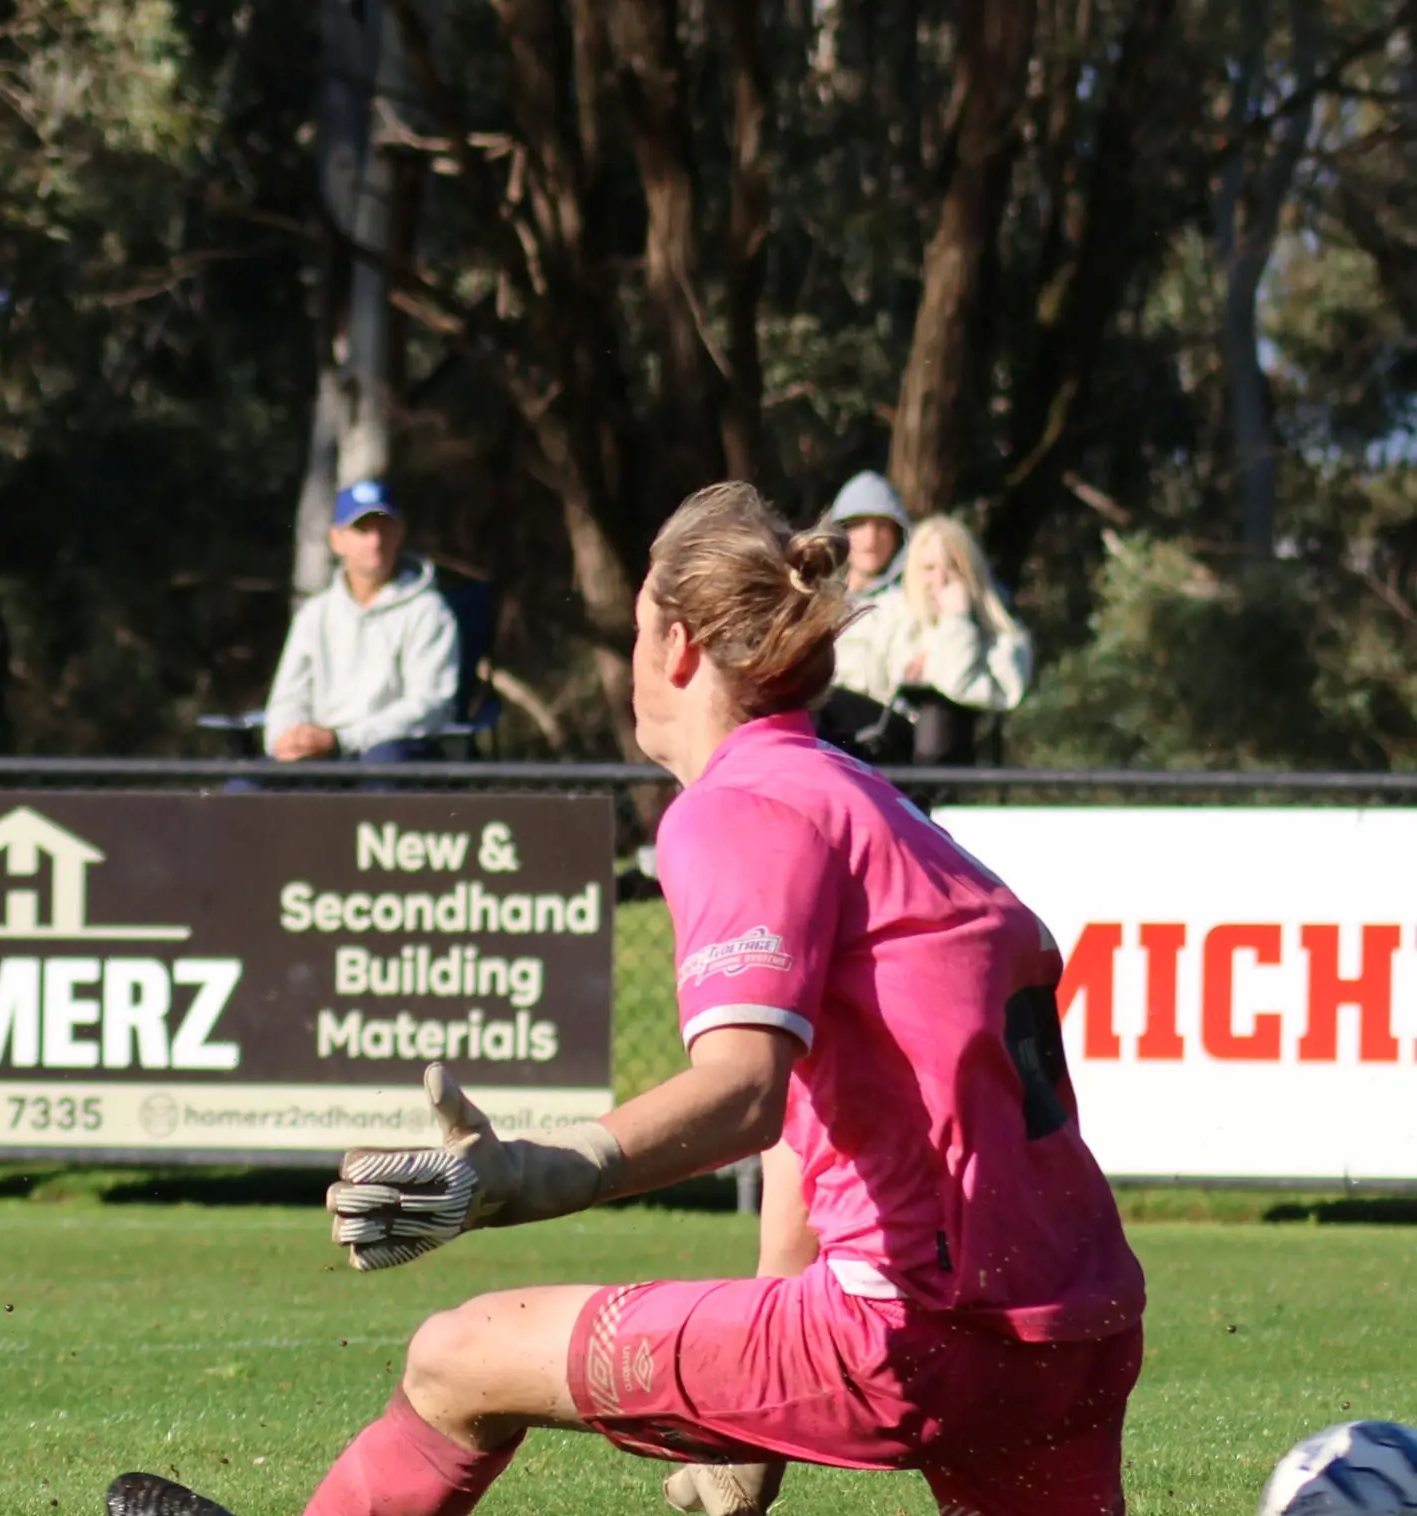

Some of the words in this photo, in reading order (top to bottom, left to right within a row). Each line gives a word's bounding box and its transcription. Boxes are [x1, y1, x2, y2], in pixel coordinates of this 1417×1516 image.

[357, 822, 467, 872] New
[478, 822, 519, 873] &
[280, 881, 601, 935] Secondhand
[335, 945, 544, 1008] Building
[1055, 921, 1417, 1063] MICH
[317, 1009, 558, 1062] Materials
[8, 1096, 103, 1131] 7335
[622, 1346, 633, 1391] umbro
